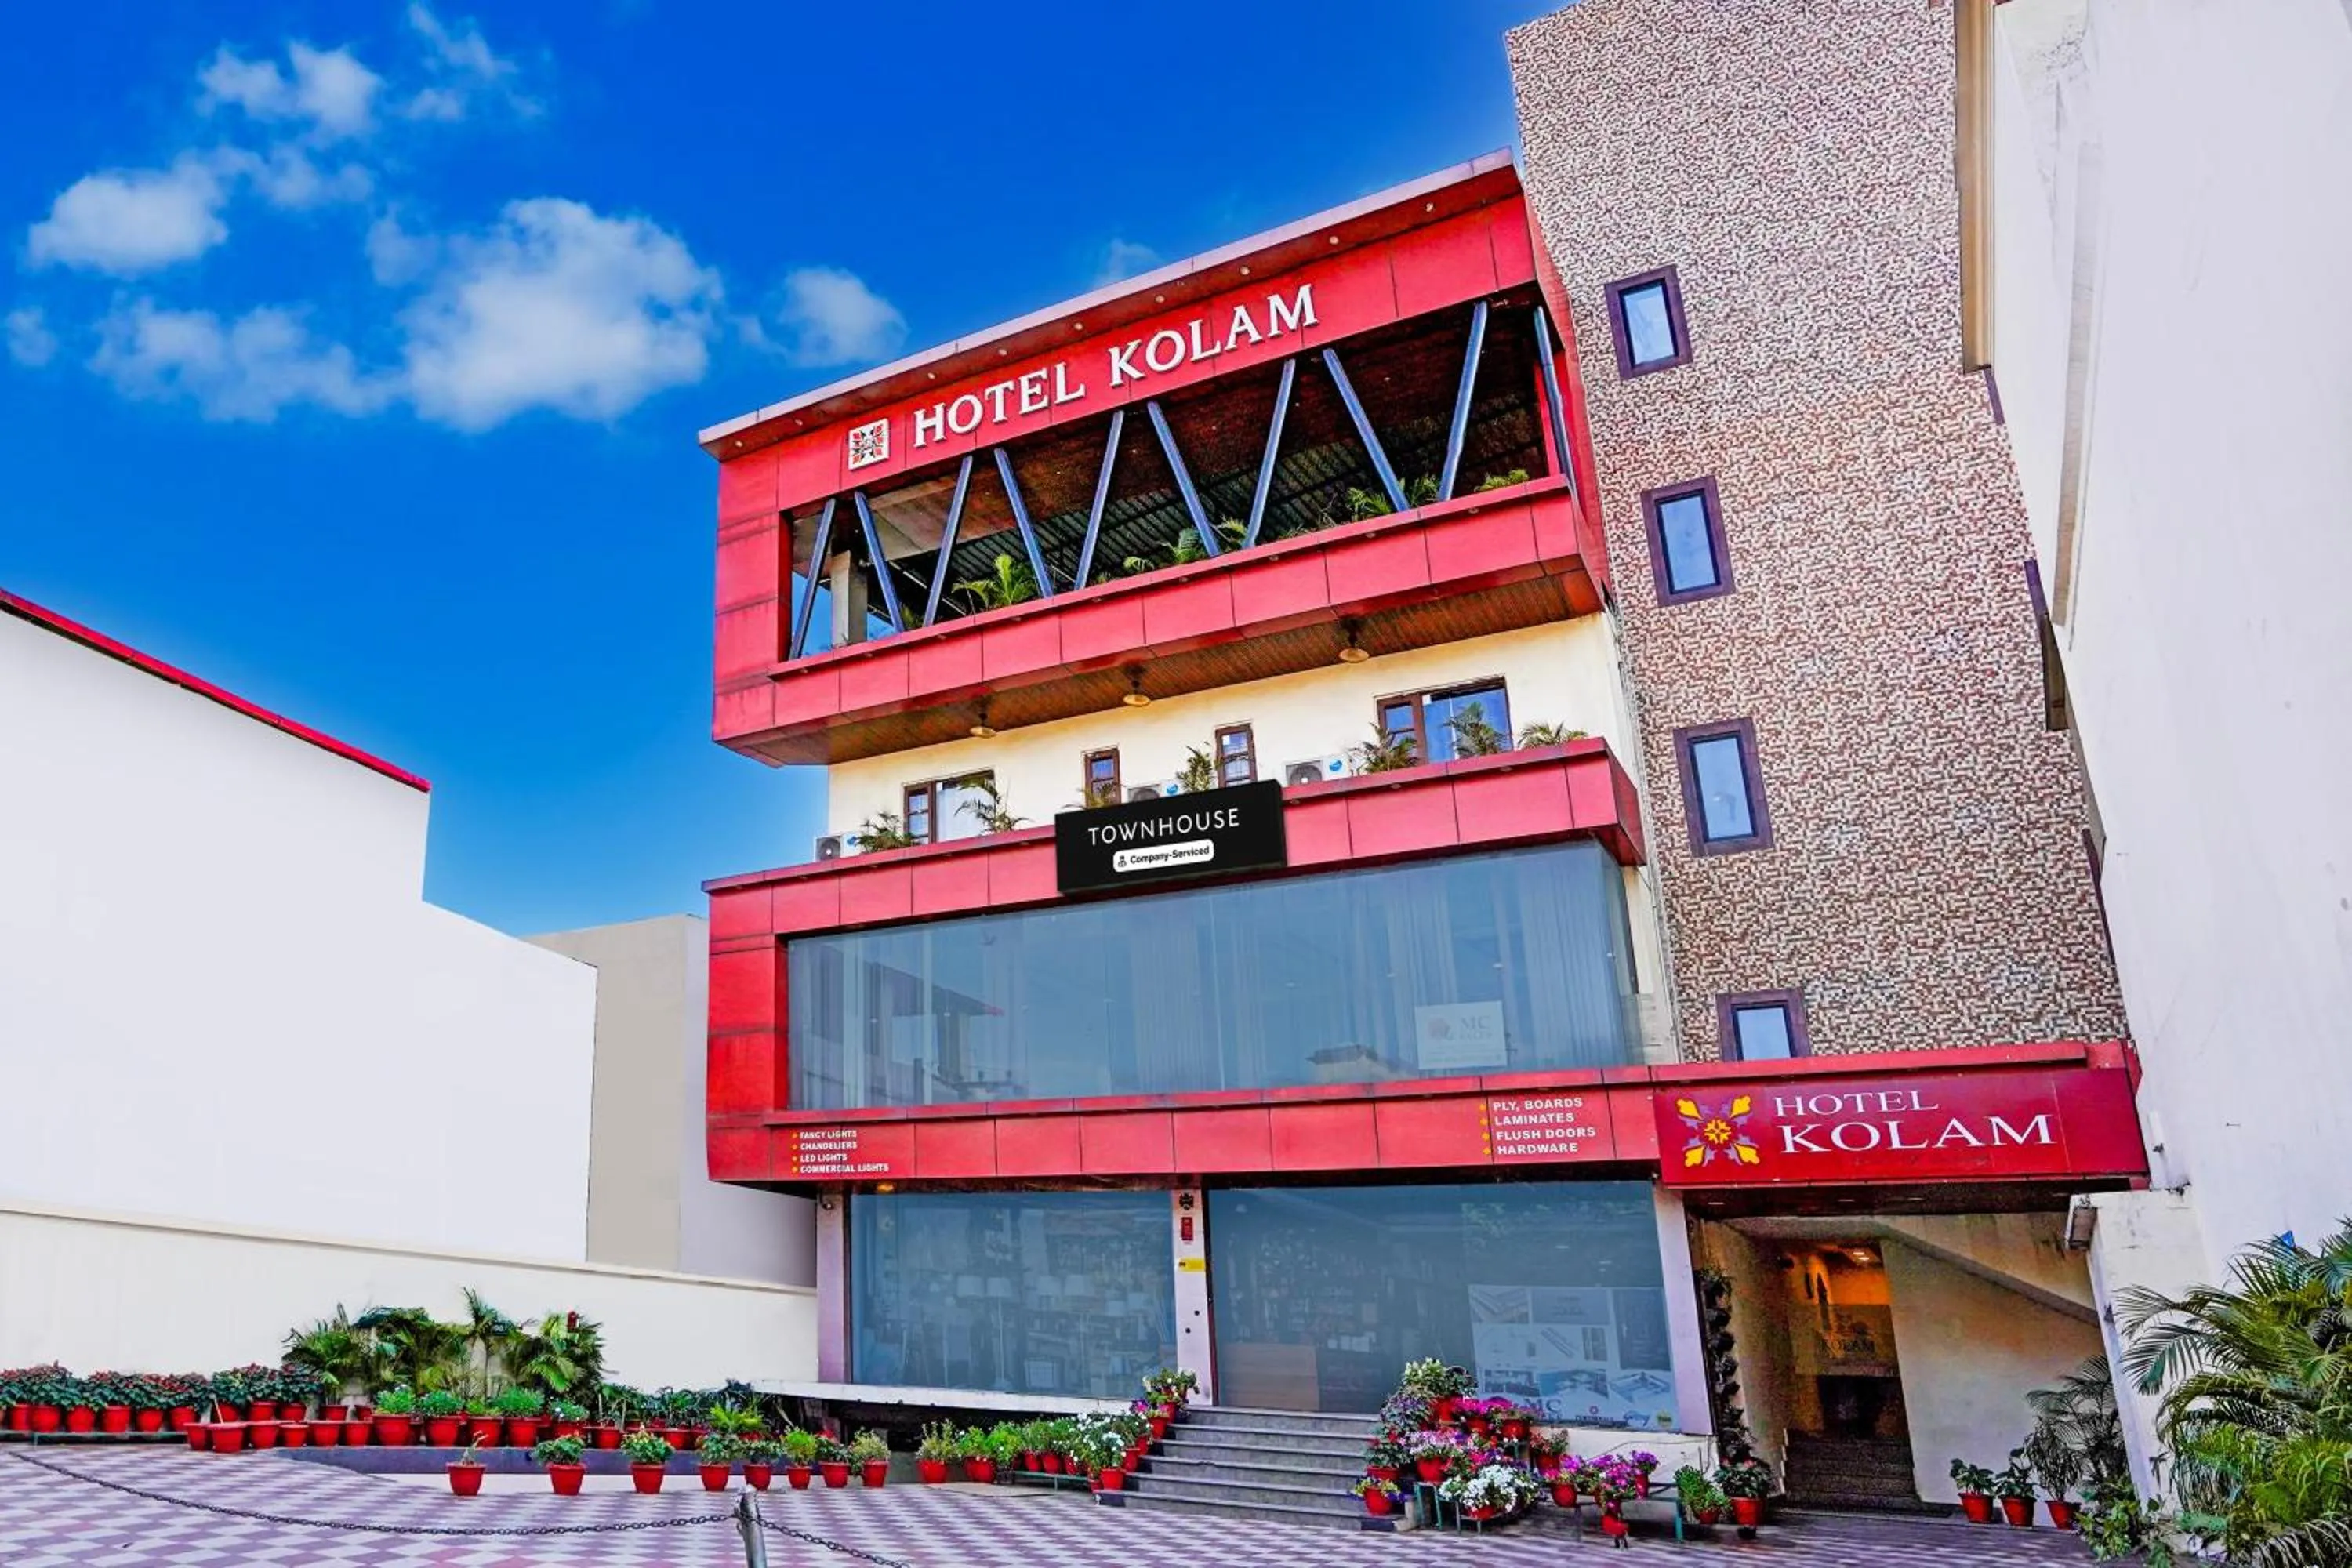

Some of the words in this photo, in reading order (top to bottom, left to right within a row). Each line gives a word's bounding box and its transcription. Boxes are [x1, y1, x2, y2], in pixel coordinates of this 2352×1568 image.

[913, 361, 1085, 449] HOTEL
[1108, 284, 1318, 387] KOLAM
[1088, 808, 1240, 845] TOWNHOUSE
[1130, 846, 1210, 864] Company-Serviced
[1524, 1098, 1583, 1110] BOARDS
[1774, 1091, 1939, 1117] HOTEL
[1494, 1112, 1575, 1126] LAMINATES
[1496, 1130, 1541, 1141] FLUSH
[1545, 1127, 1596, 1139] DOORS
[1780, 1114, 2058, 1154] KOLAM
[800, 1141, 858, 1150] CHANDELIERS
[1497, 1142, 1578, 1155] HARDWARE
[818, 1152, 848, 1161] LIGHTS
[800, 1164, 855, 1174] COMMERCIAL
[858, 1163, 889, 1172] LIGHTS
